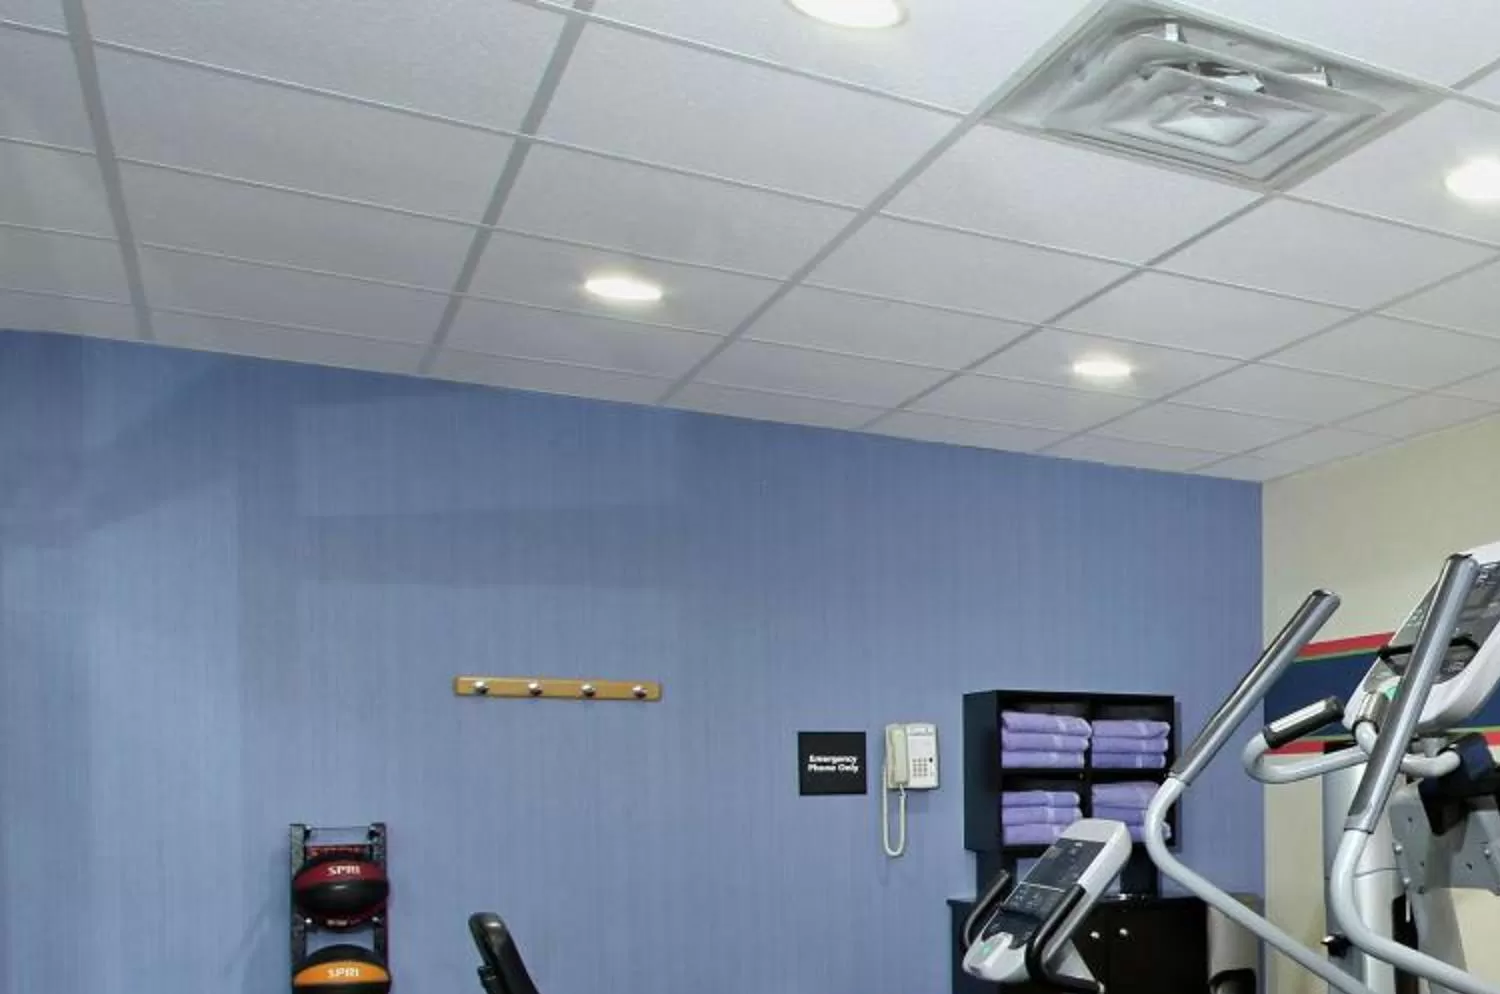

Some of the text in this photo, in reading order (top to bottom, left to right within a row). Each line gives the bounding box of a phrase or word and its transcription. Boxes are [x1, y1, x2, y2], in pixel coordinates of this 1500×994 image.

[808, 754, 857, 765] Emergency
[807, 763, 859, 775] Phone Only
[326, 865, 361, 877] SPRI
[326, 966, 360, 979] SPRI
